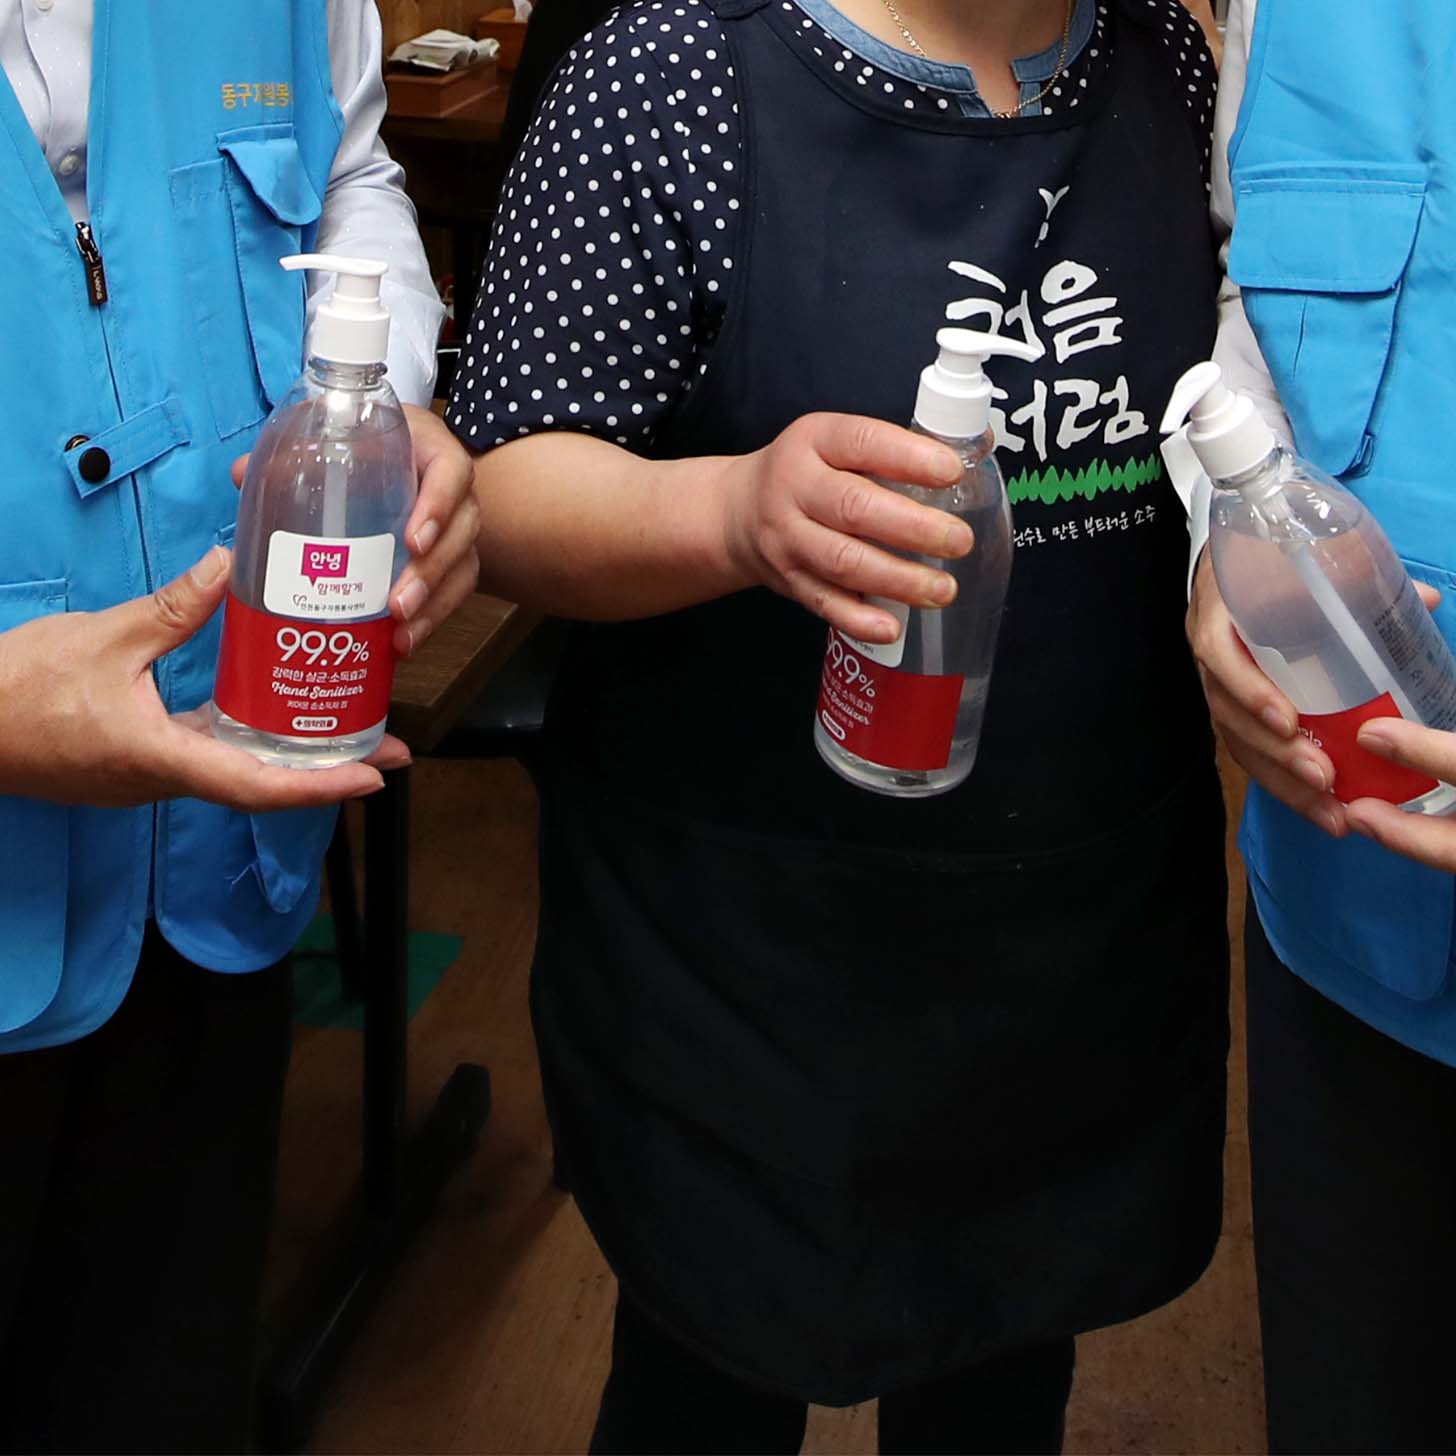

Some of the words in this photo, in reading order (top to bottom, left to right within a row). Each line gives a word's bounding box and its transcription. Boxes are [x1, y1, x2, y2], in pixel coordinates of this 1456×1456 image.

[1052, 521, 1079, 541] 만든
[1084, 510, 1130, 538] 부드러운
[1134, 504, 1156, 525] 소주
[310, 551, 342, 572] 안녕
[276, 626, 370, 666] 99.9%
